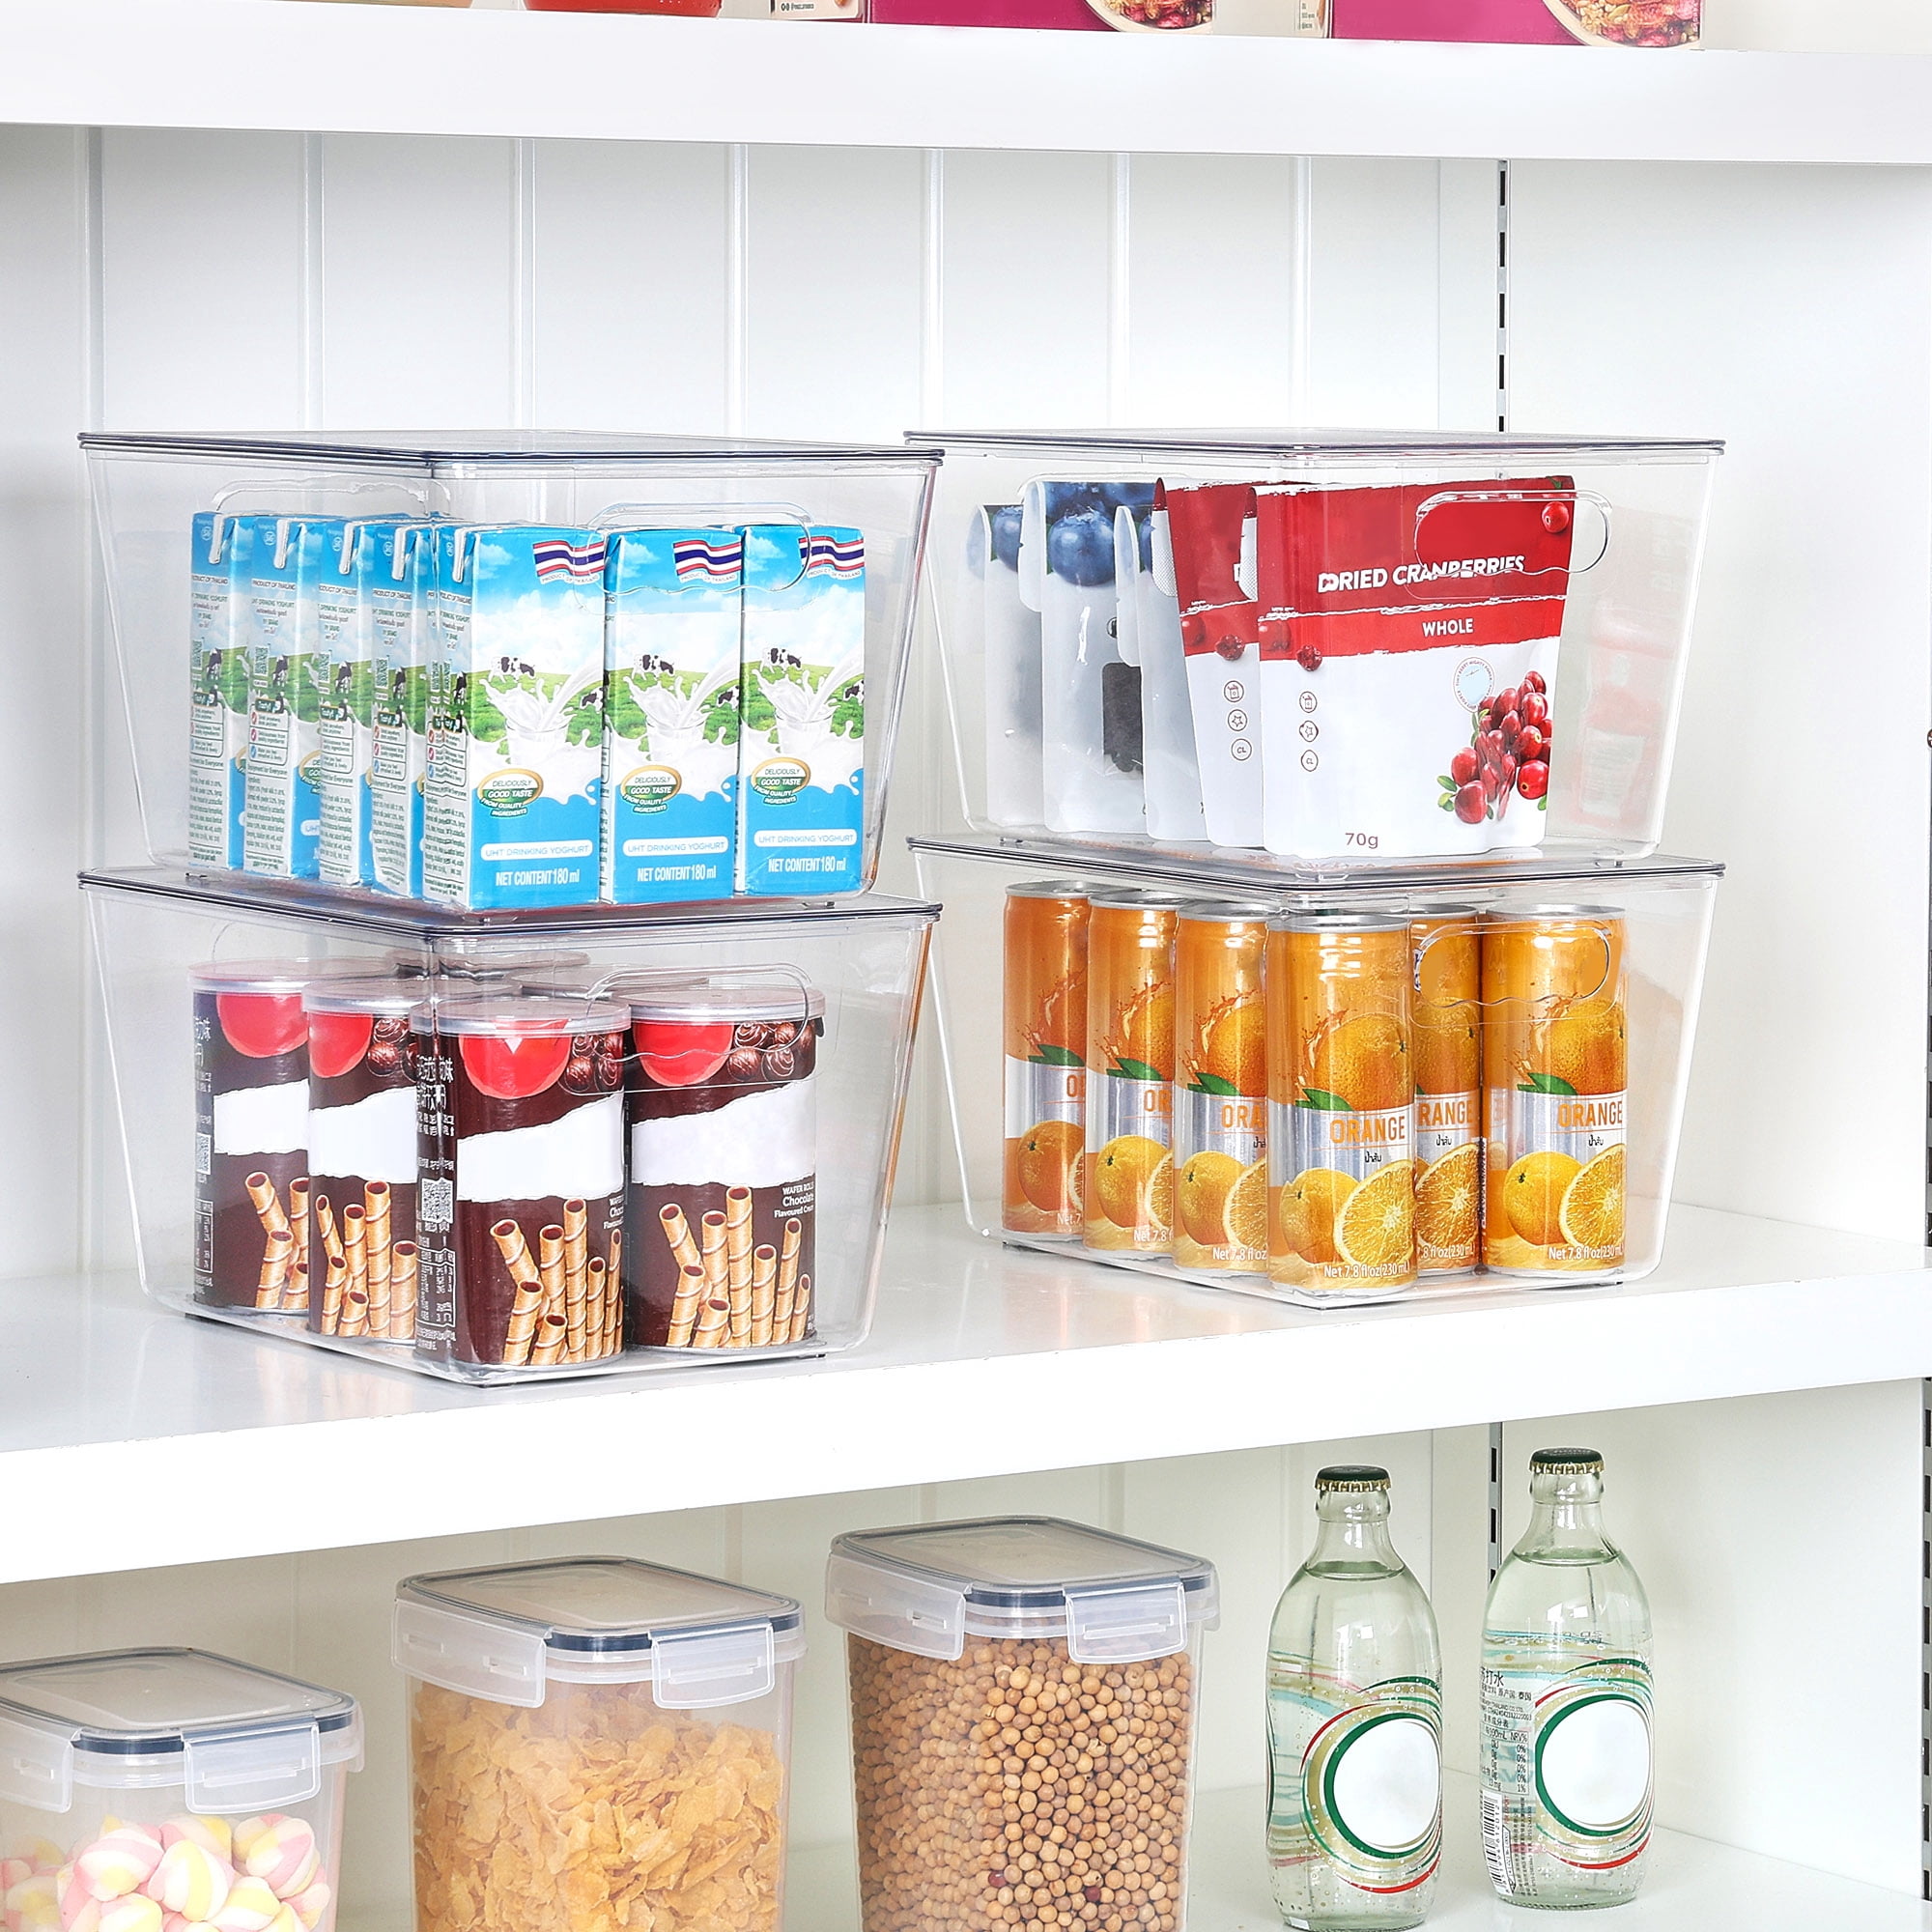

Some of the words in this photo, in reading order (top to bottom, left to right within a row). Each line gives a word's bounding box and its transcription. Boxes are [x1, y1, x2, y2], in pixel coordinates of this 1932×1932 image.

[1318, 571, 1388, 592] DRIED
[1423, 618, 1473, 637] WHOLE
[754, 785, 769, 794] FROM
[481, 798, 497, 808] FROM
[624, 793, 639, 804] FROM
[688, 841, 725, 850] YOGHURT
[1345, 833, 1378, 849] 70g
[507, 847, 548, 856] DRINKING
[550, 845, 589, 854] YOGHURT
[768, 859, 783, 872] NET
[785, 857, 821, 872] CONTENT
[821, 856, 836, 872] 180
[837, 858, 846, 871] ml
[496, 871, 513, 886] NET
[514, 870, 553, 886] CONTENT
[554, 867, 568, 885] 180
[569, 869, 580, 883] ml
[638, 867, 653, 882] NET
[655, 866, 691, 881] CONTENT
[692, 864, 706, 880] 180
[706, 866, 717, 879] ml
[1418, 1100, 1473, 1126] RANGE
[1557, 1100, 1622, 1127] ORANGE
[1329, 1116, 1405, 1144] ORANGE
[782, 1184, 803, 1195] WAFER
[774, 1207, 803, 1217] Flavoured
[1212, 1247, 1229, 1260] Net
[1548, 1248, 1566, 1260] Net
[1568, 1247, 1581, 1260] 7.8
[1324, 1265, 1342, 1277] Net
[1345, 1264, 1358, 1277] 7.8
[1361, 1264, 1367, 1277] fl
[1518, 1783, 1526, 1793] 1%
